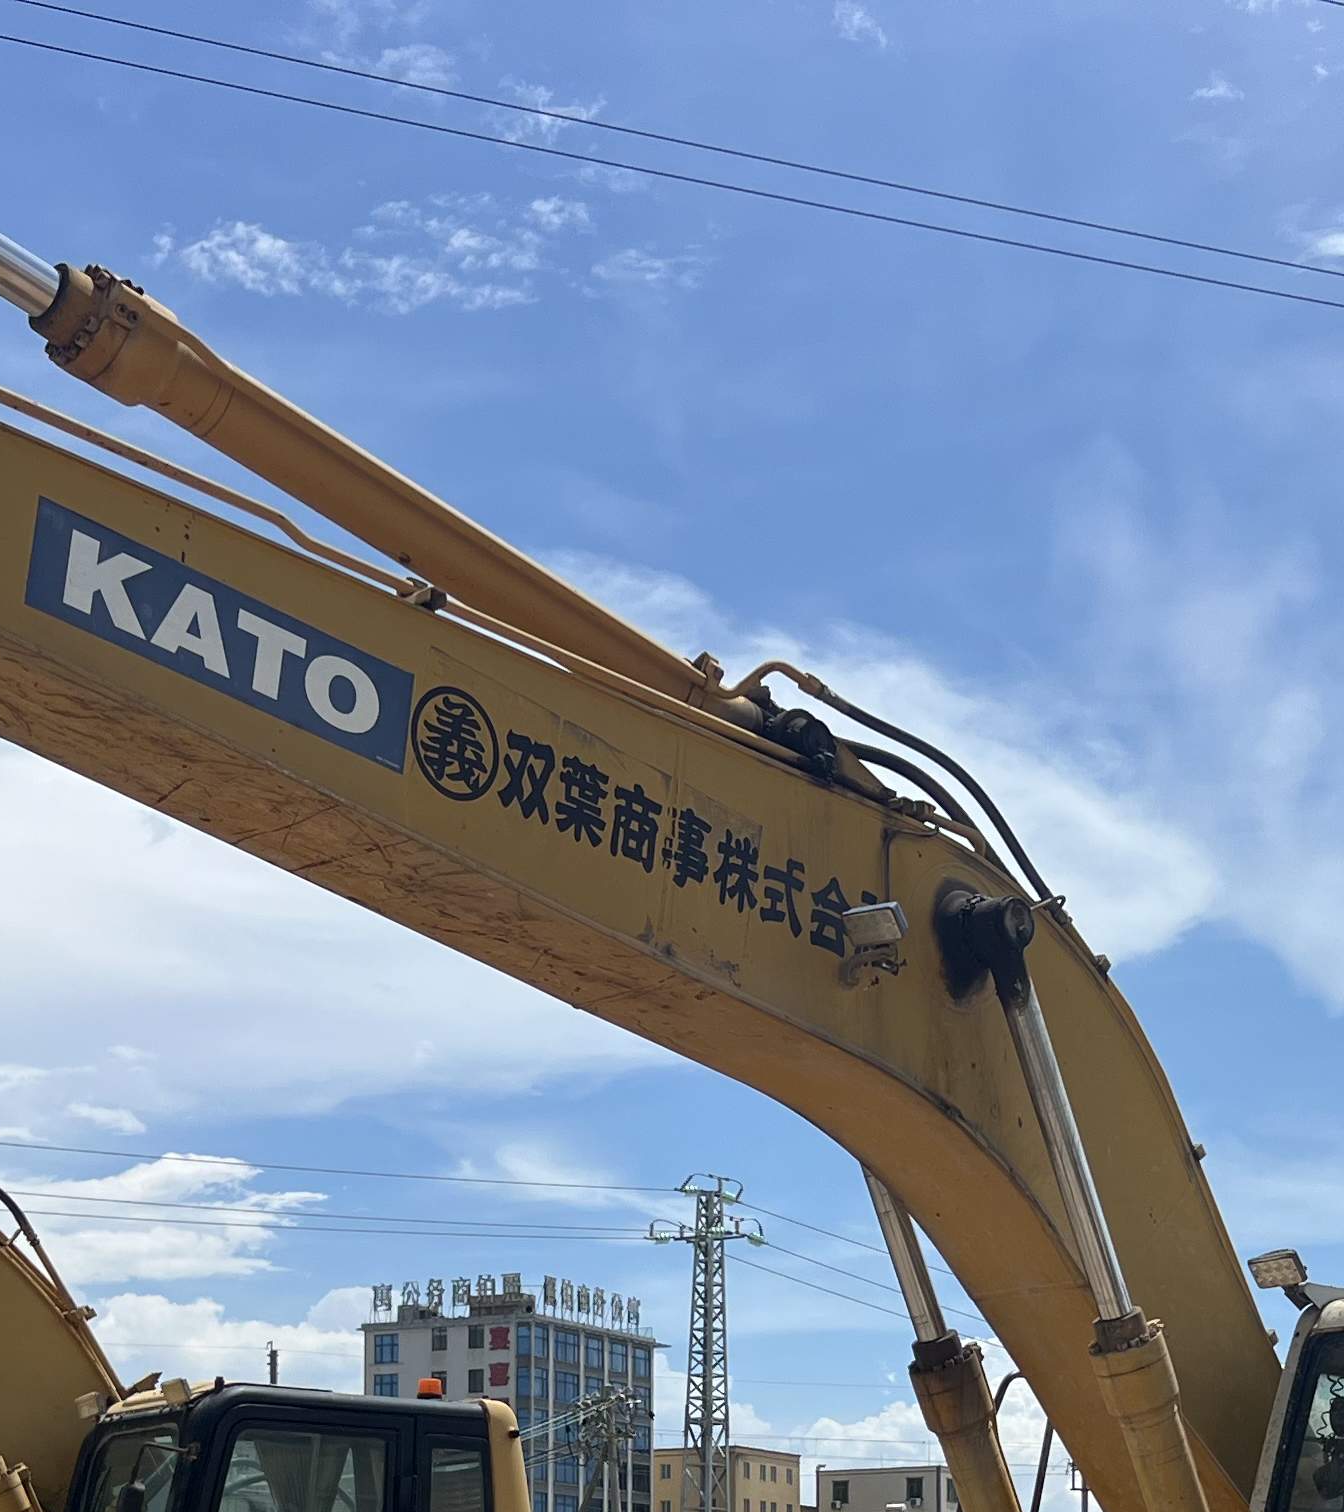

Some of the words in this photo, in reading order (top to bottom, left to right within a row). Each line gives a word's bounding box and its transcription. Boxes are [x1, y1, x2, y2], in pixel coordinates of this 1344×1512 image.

[61, 529, 380, 735] KATO
[497, 729, 878, 957] 双葉商事株式会
